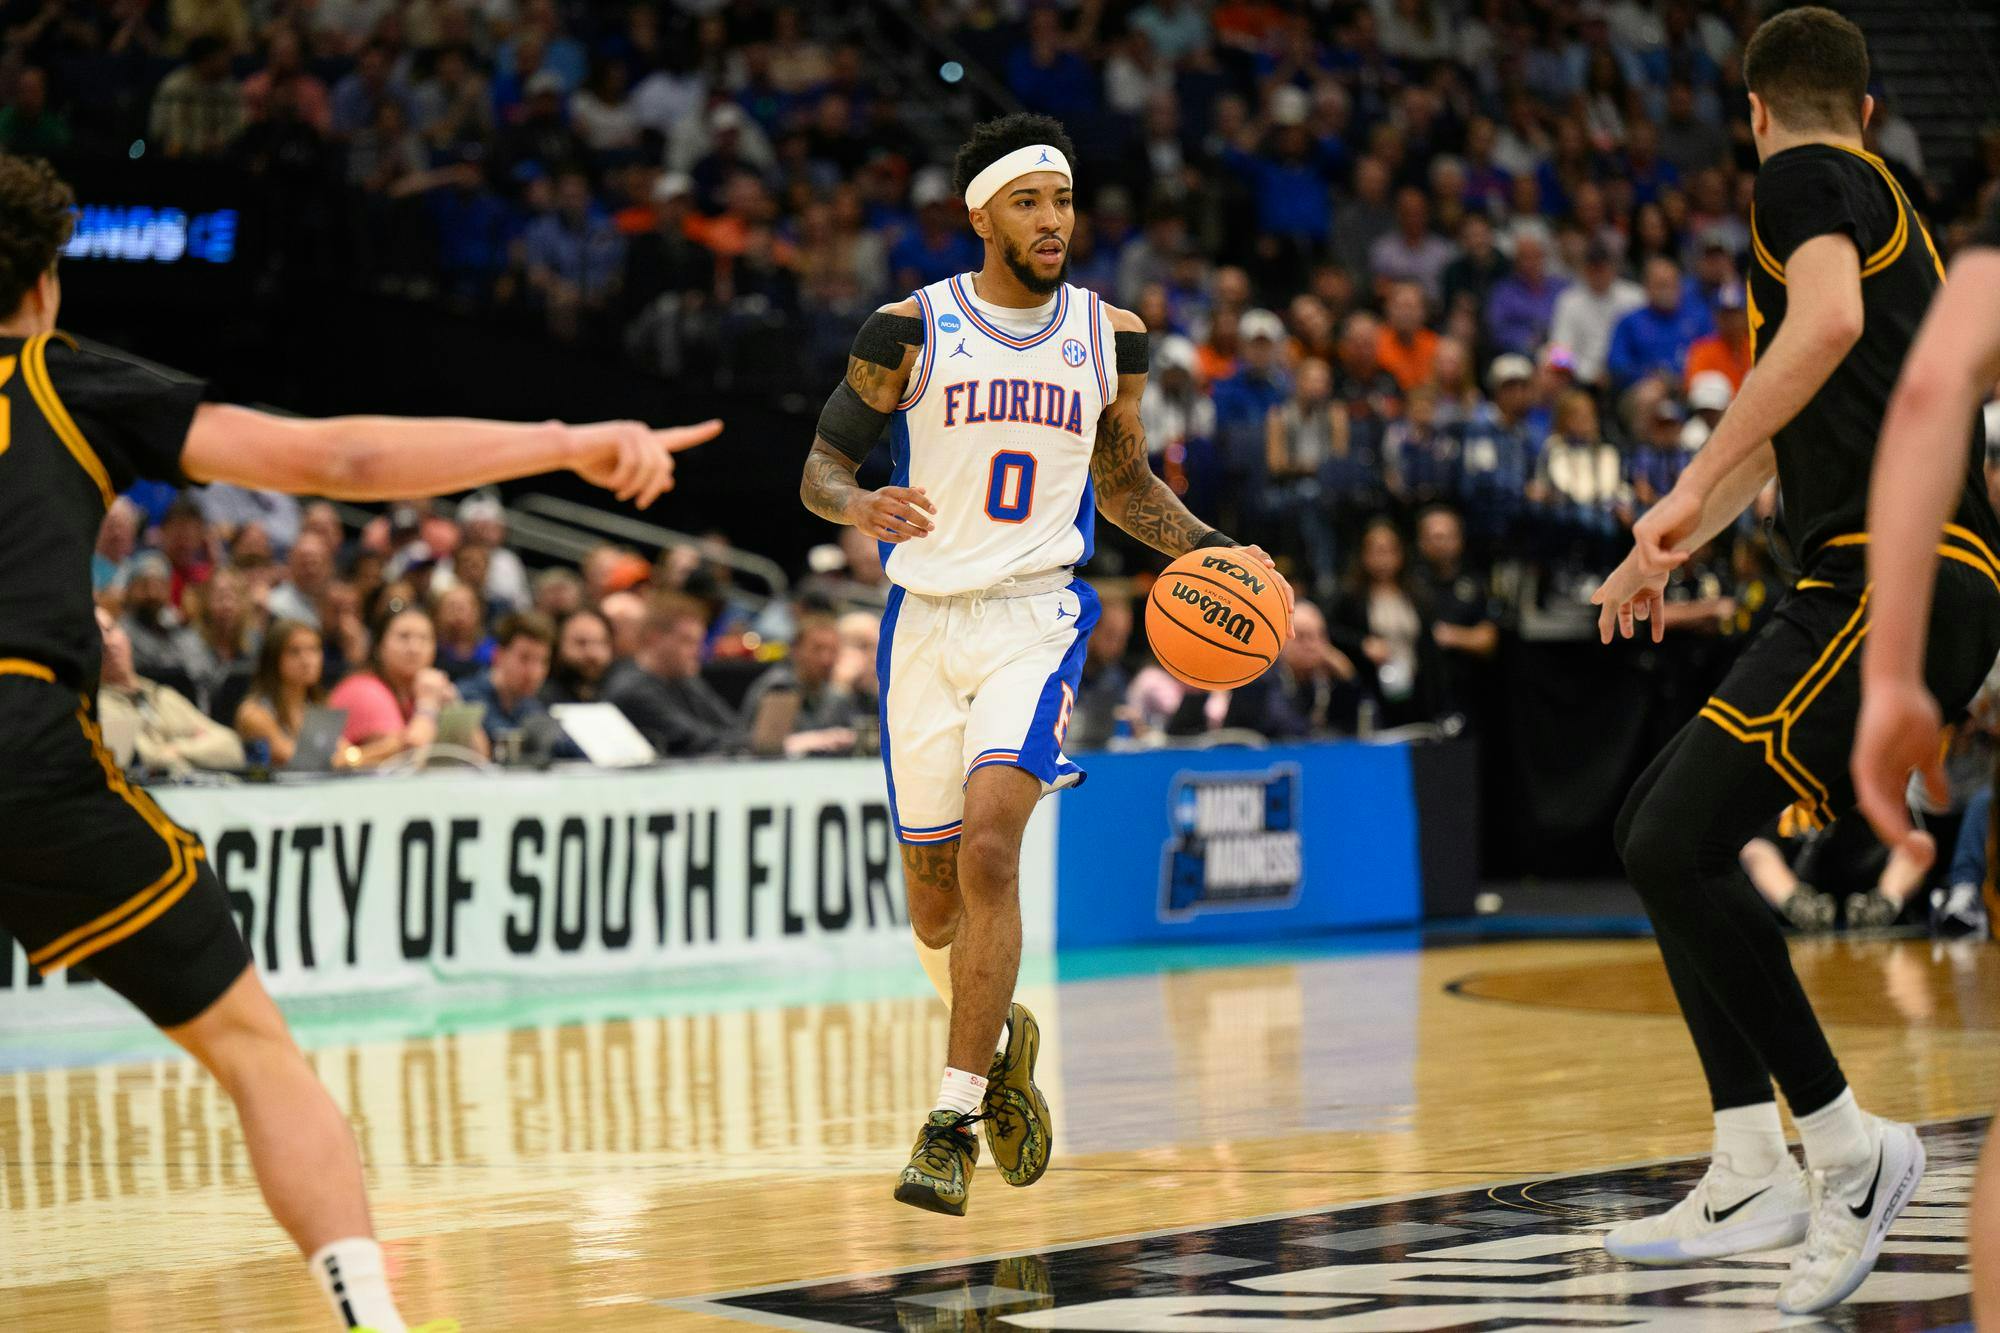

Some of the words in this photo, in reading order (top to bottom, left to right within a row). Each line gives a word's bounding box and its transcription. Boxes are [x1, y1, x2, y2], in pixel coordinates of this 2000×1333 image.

[940, 321, 960, 329] NCAA
[1064, 341, 1086, 366] SEC
[943, 378, 1083, 436] FLORIDA
[984, 449, 1038, 524] 0
[1201, 556, 1265, 595] NCAA
[1171, 581, 1255, 645] Wilson
[216, 821, 372, 972] SITY
[400, 817, 480, 960] OF
[504, 807, 718, 955] SOUTH
[745, 801, 900, 939] FLOR
